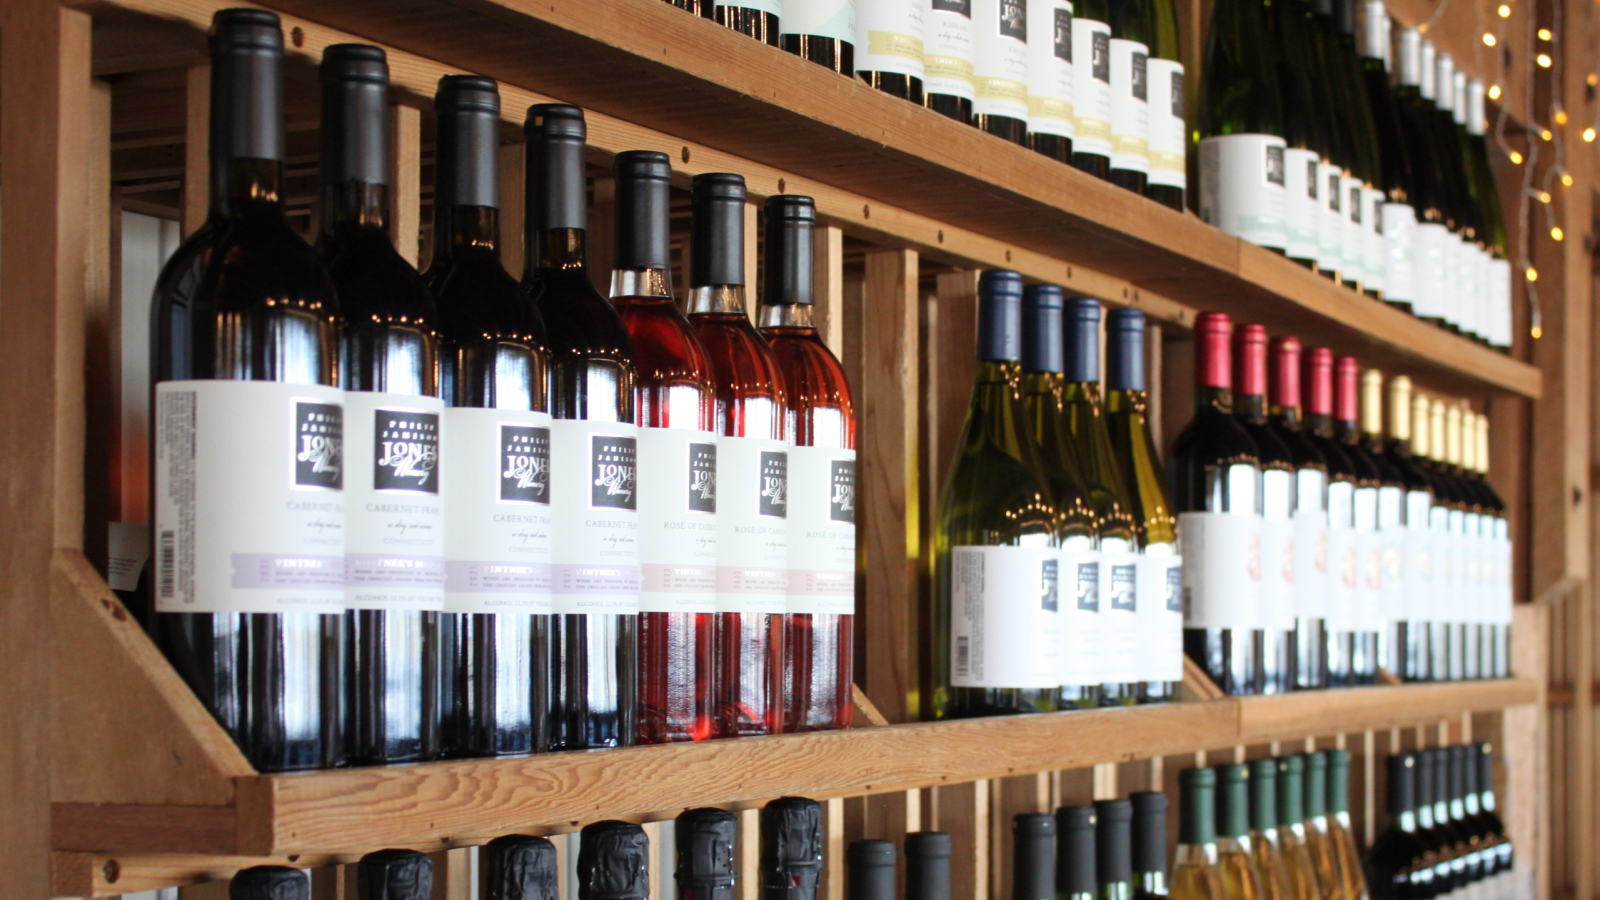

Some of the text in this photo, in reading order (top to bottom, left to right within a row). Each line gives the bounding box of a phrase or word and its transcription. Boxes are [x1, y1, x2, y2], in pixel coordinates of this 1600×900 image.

[378, 442, 437, 466] JONES
[365, 503, 419, 514] CABERNET
[492, 514, 538, 524] CABERNET
[585, 519, 626, 529] CABERNET
[663, 520, 685, 529] ROSÉ
[687, 522, 697, 530] OF
[734, 525, 755, 534] ROSÉ
[806, 530, 826, 539] ROSÉ
